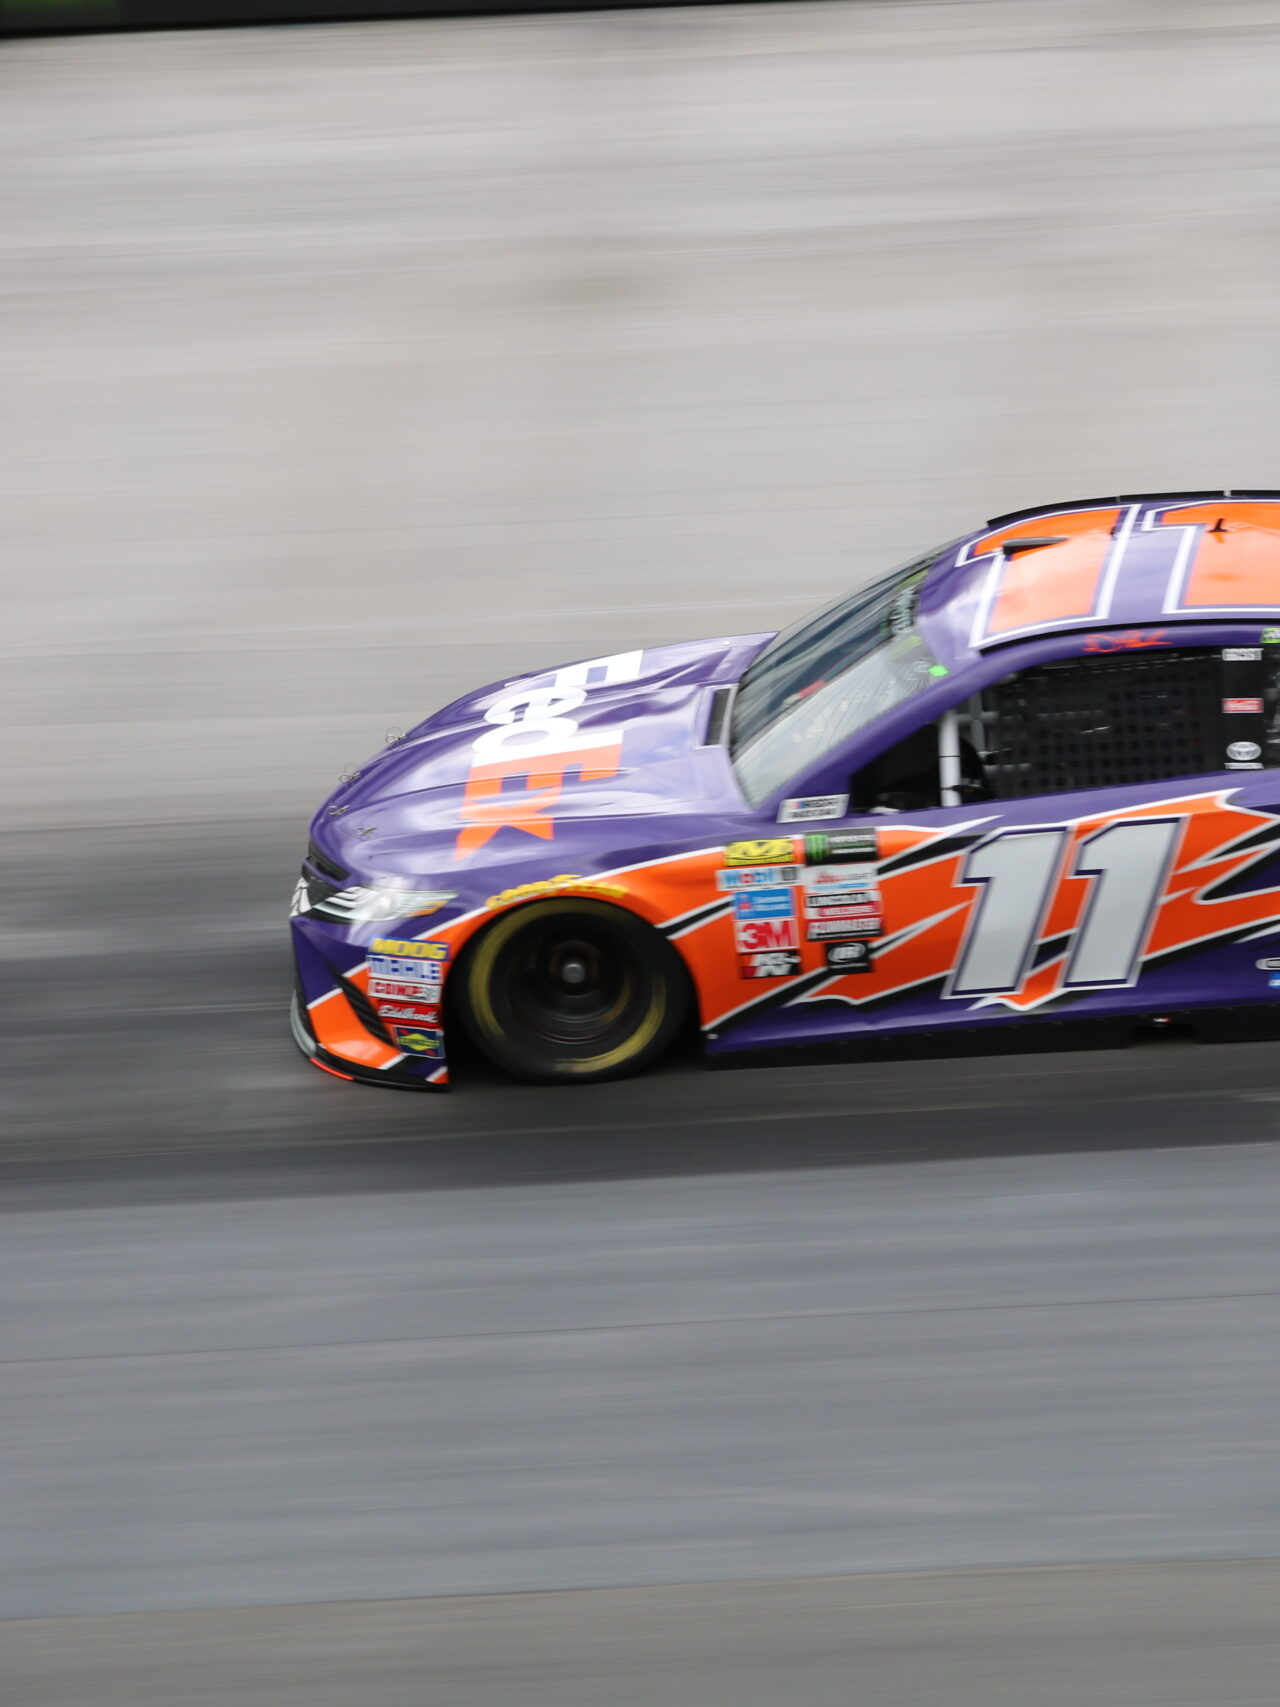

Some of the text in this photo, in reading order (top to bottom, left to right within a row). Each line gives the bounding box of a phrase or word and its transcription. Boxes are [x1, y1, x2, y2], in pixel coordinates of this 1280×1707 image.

[454, 649, 644, 863] FedEx
[369, 937, 450, 960] MOOG
[741, 920, 796, 949] 3M
[940, 813, 1193, 1000] 11
